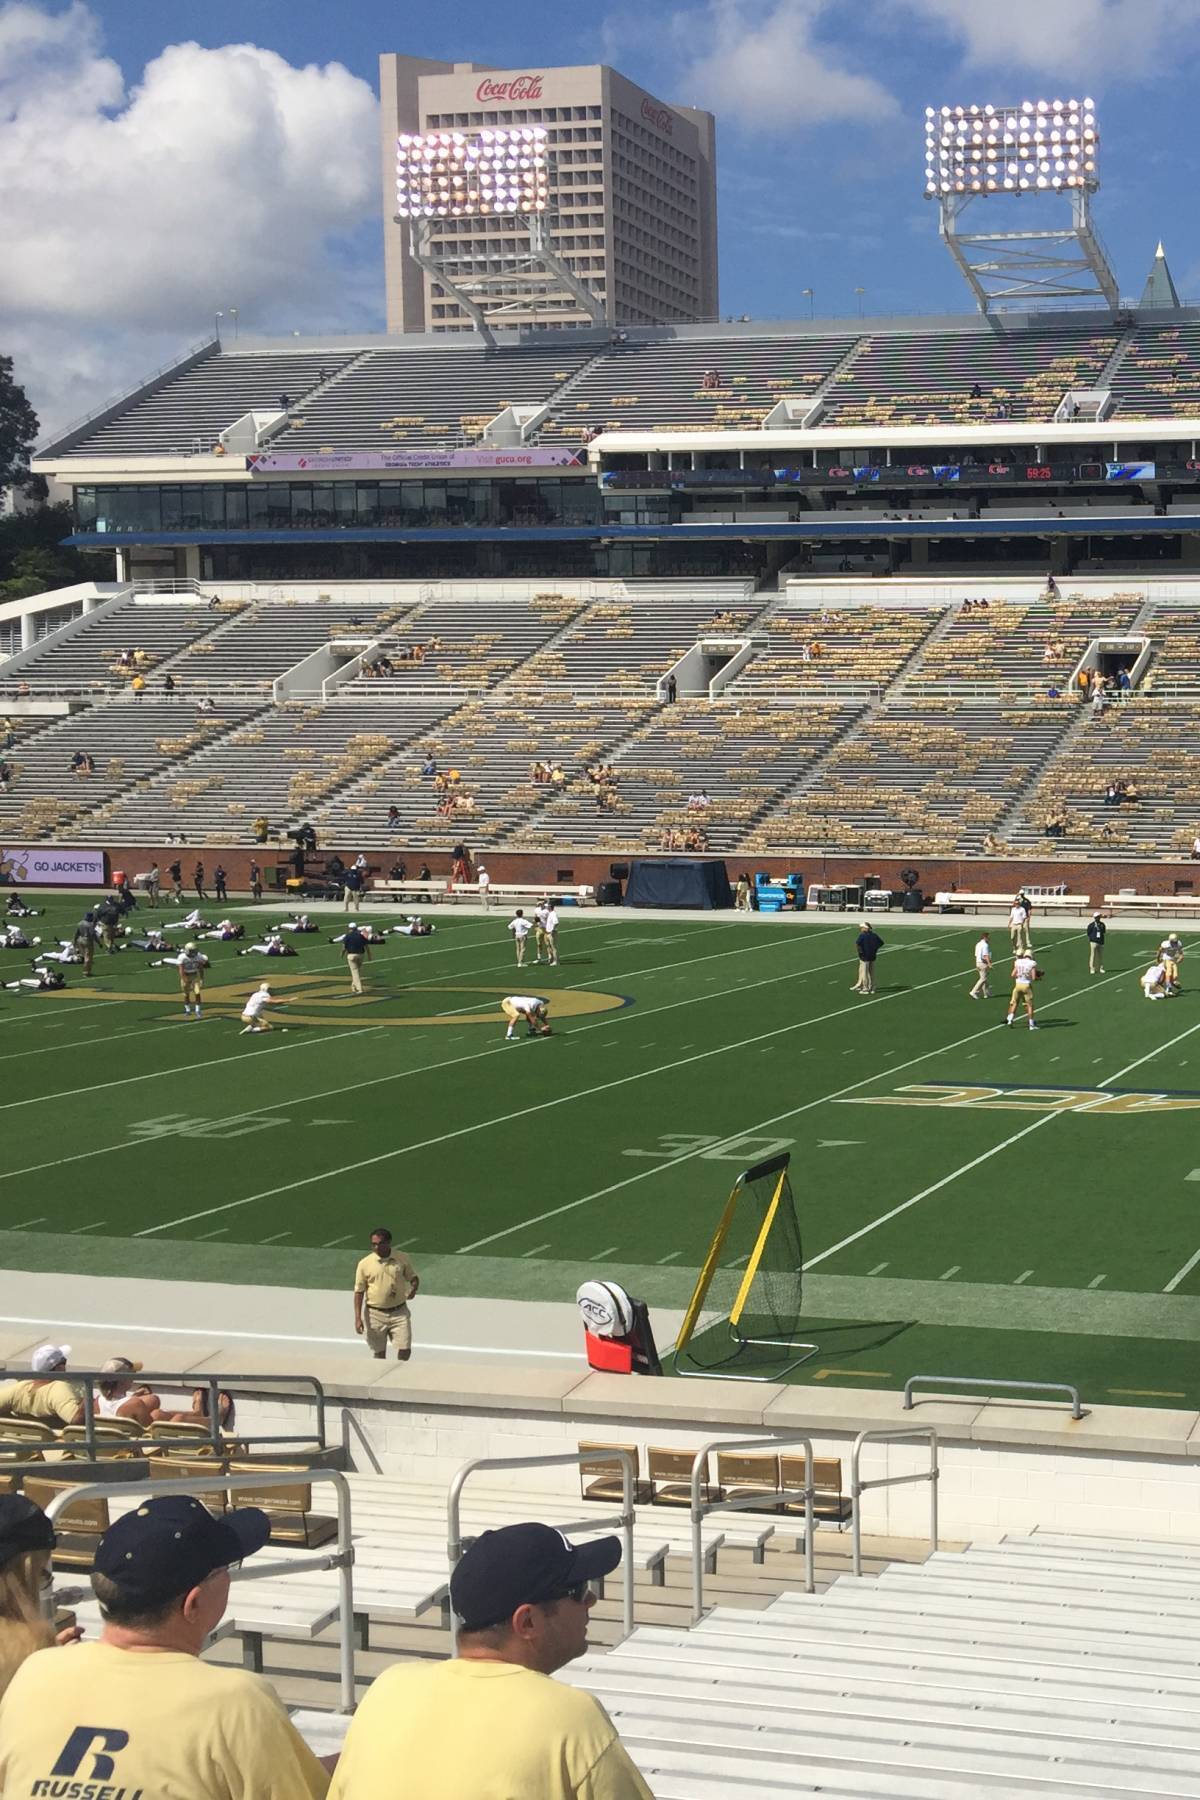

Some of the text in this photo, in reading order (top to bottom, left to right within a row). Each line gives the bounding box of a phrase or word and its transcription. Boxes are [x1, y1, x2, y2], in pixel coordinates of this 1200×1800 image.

[476, 75, 544, 102] Coca-Cola
[496, 455, 532, 465] gucu.org
[34, 861, 49, 872] GO
[583, 1303, 608, 1319] ACC
[50, 1725, 129, 1782] R
[31, 1779, 144, 1800] RUSSELL
